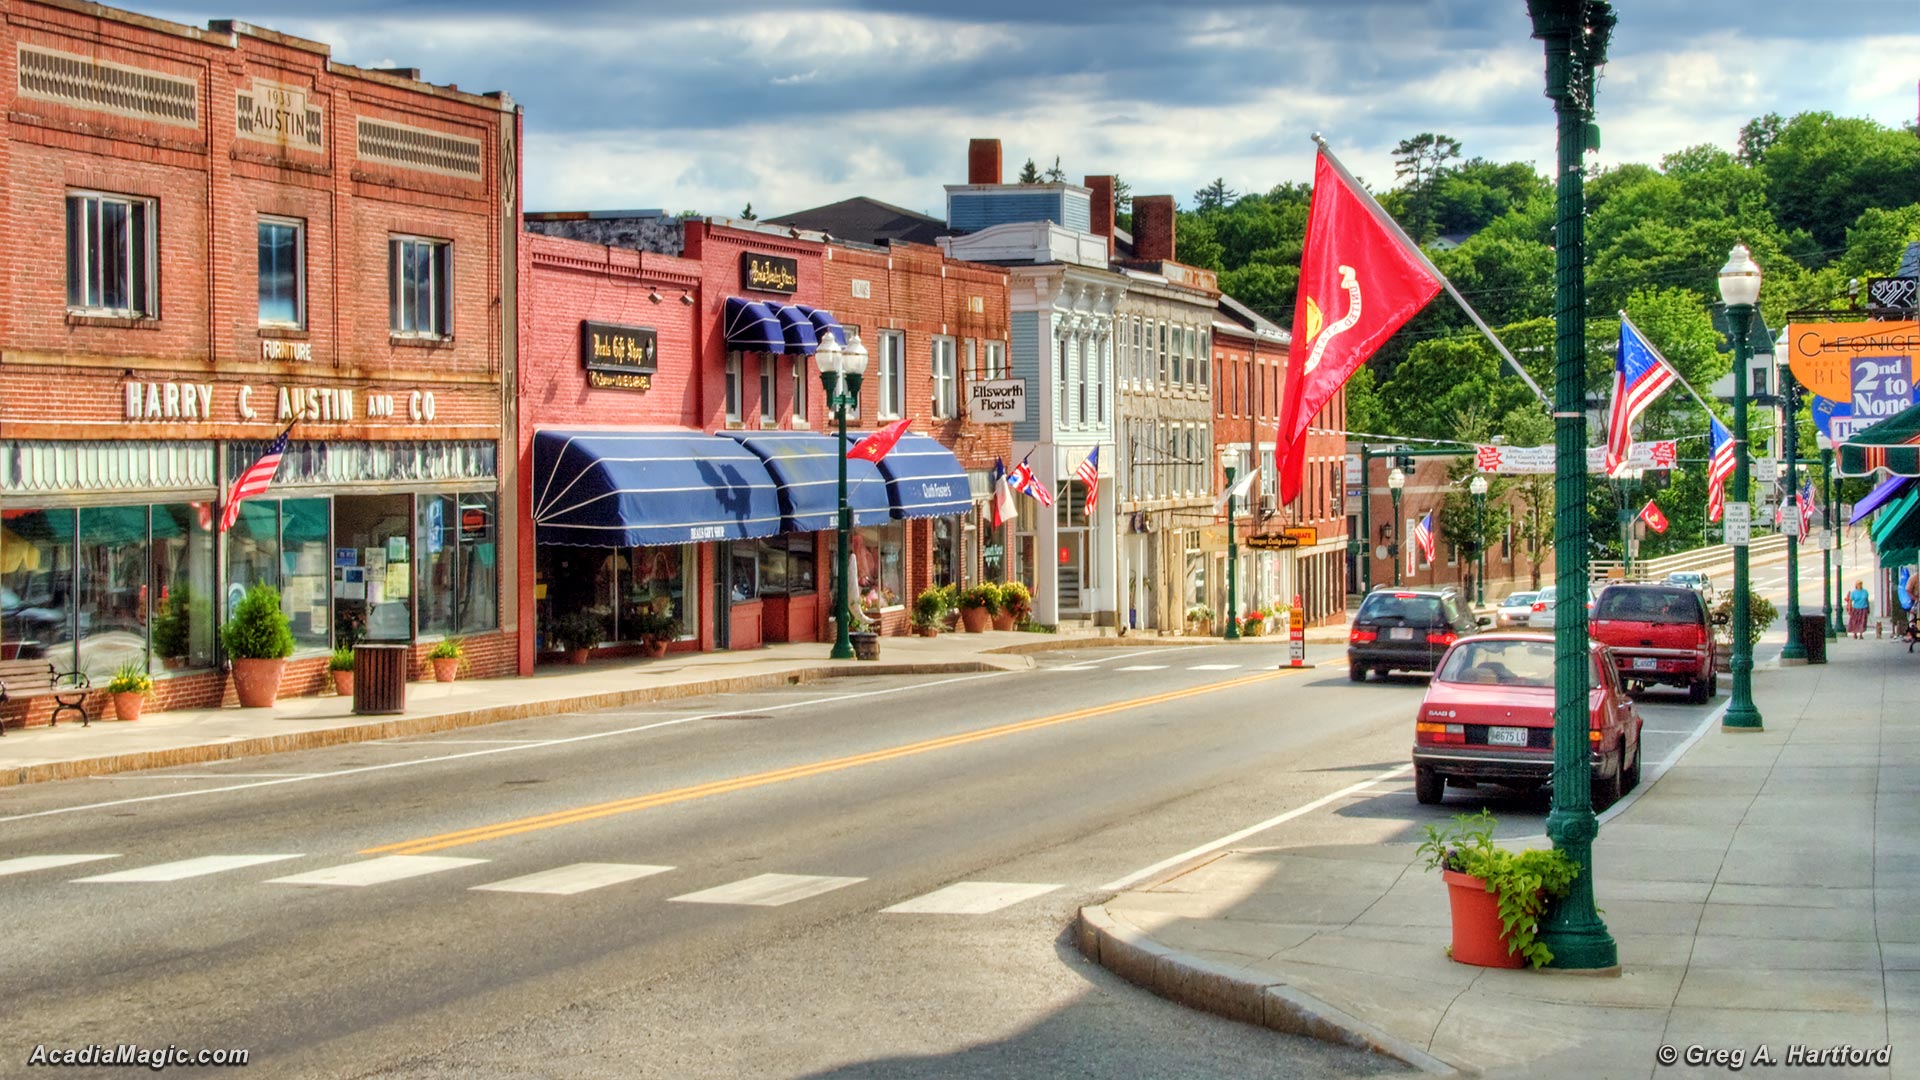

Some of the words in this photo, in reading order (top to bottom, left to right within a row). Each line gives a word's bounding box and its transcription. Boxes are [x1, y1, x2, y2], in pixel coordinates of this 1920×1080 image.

[267, 89, 291, 107] 1933
[254, 105, 305, 137] AUSTIN
[262, 340, 312, 361] FURNITURE
[1854, 360, 1901, 391] 2nd
[973, 385, 1023, 398] Ellsworth
[1885, 377, 1908, 396] to
[126, 382, 213, 419] HARRY
[278, 386, 353, 420] AUSTIN
[368, 394, 394, 417] AND
[981, 398, 1015, 410] Florist
[1853, 393, 1910, 416] None
